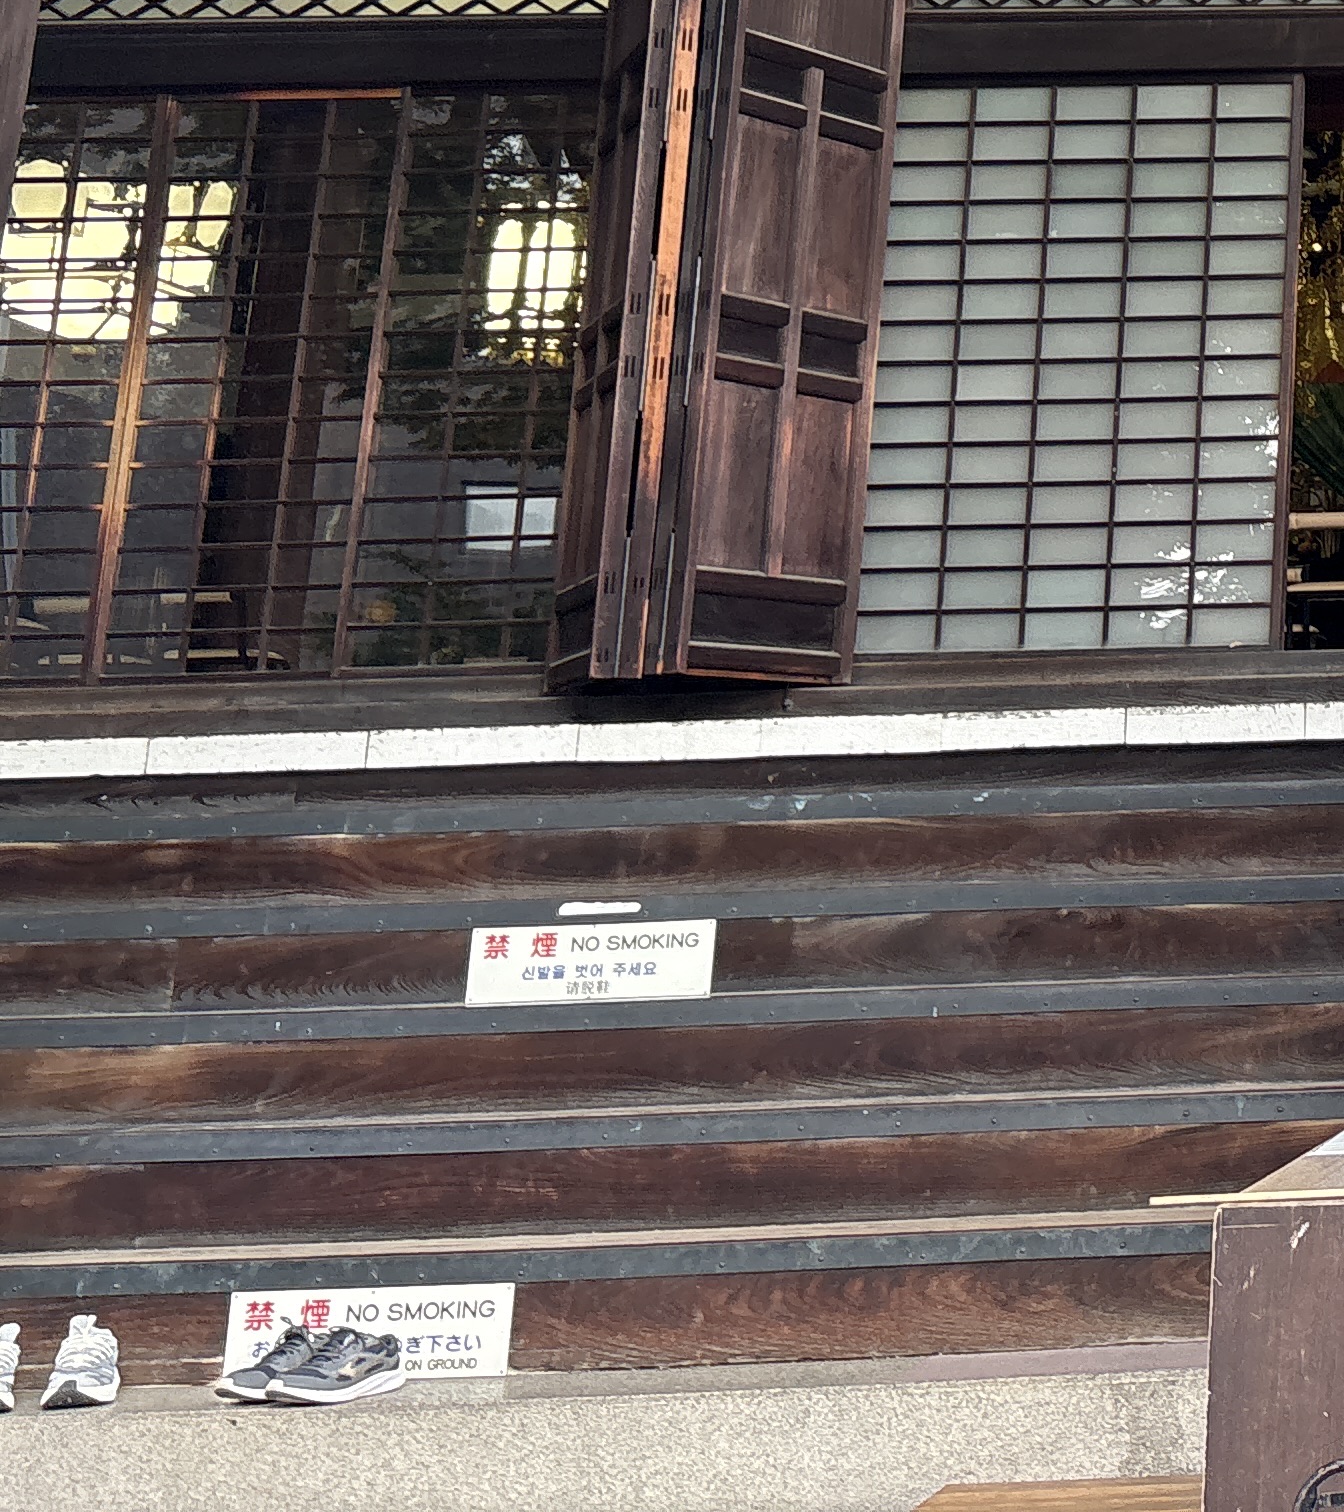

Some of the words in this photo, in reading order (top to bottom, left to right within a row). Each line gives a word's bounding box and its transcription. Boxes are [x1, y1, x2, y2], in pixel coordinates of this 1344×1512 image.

[570, 935, 600, 952] NO
[606, 933, 700, 951] SMOKING
[521, 964, 566, 980] 신발을
[575, 963, 603, 979] 벗어
[613, 961, 657, 977] 주세요
[345, 1303, 380, 1323] NO
[386, 1300, 496, 1321] SMOKING
[404, 1359, 423, 1371] ON
[427, 1357, 478, 1371] GROUND
